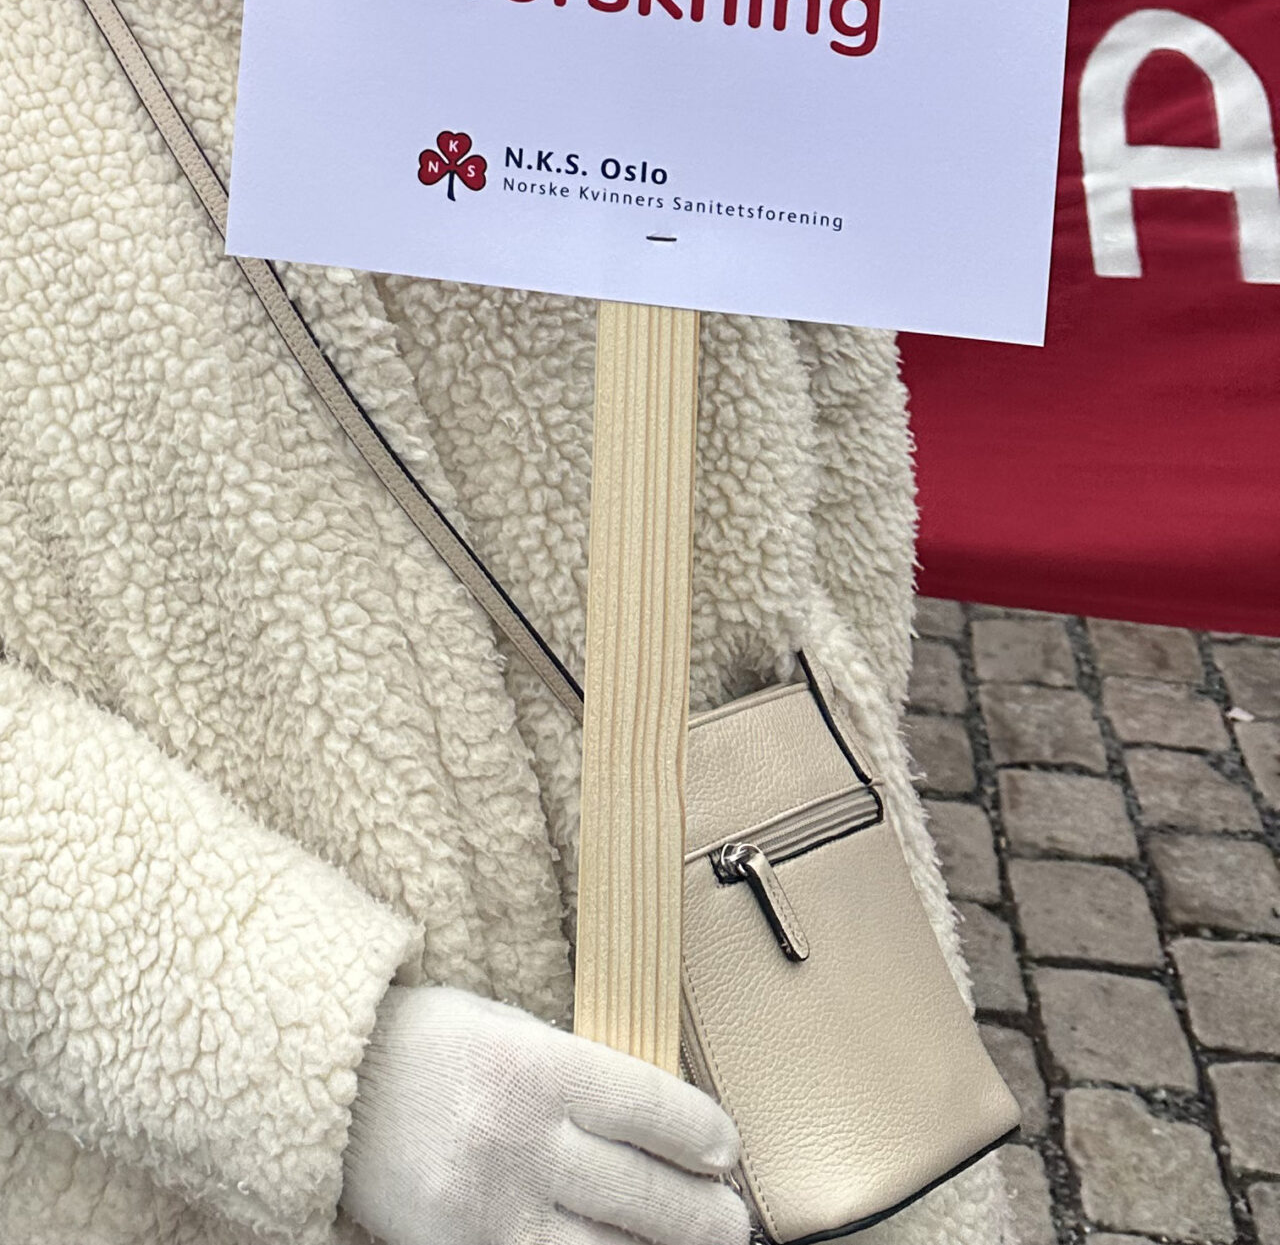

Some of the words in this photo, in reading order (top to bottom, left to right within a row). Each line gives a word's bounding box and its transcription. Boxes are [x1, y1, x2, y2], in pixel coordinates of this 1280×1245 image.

[505, 146, 589, 177] N.K.S.
[600, 157, 669, 186] Oslo
[503, 177, 571, 199] Norske
[579, 186, 665, 210] Kvinners
[672, 196, 844, 232] Sanitetsforening
